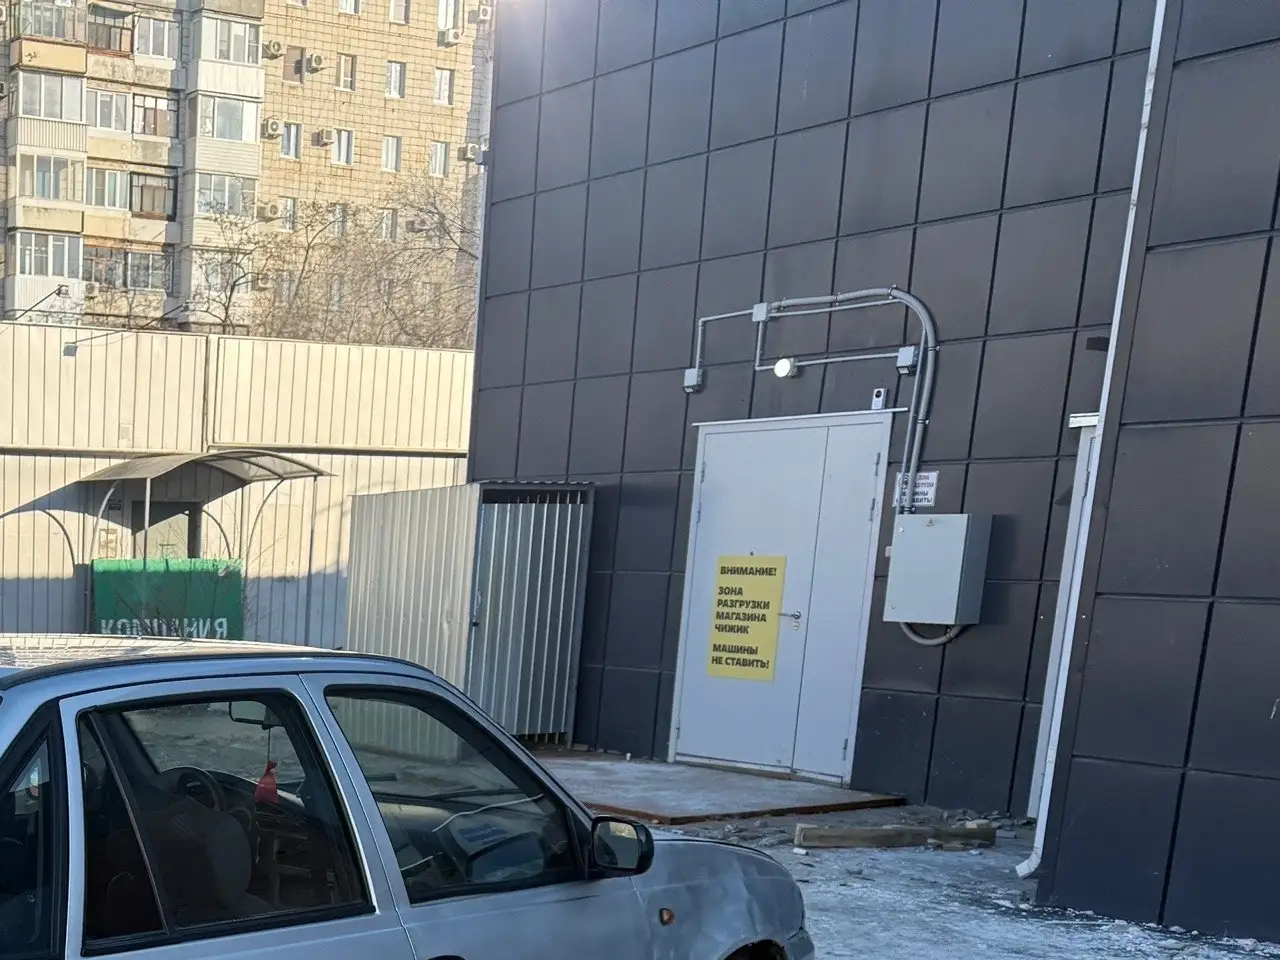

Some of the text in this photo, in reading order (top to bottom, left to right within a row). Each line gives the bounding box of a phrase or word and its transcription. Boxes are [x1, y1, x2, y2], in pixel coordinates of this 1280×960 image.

[720, 566, 777, 576] ВНИМАНИЕ!
[718, 586, 743, 596] ЗОНА
[717, 599, 770, 610] РАЗГРУЗКИ
[716, 611, 767, 622] МАГАЗИНА
[715, 624, 749, 634] ЧИЖИК
[712, 643, 758, 655] МАШИНЫ
[711, 656, 770, 669] НЕ СТАВИТЬ!
